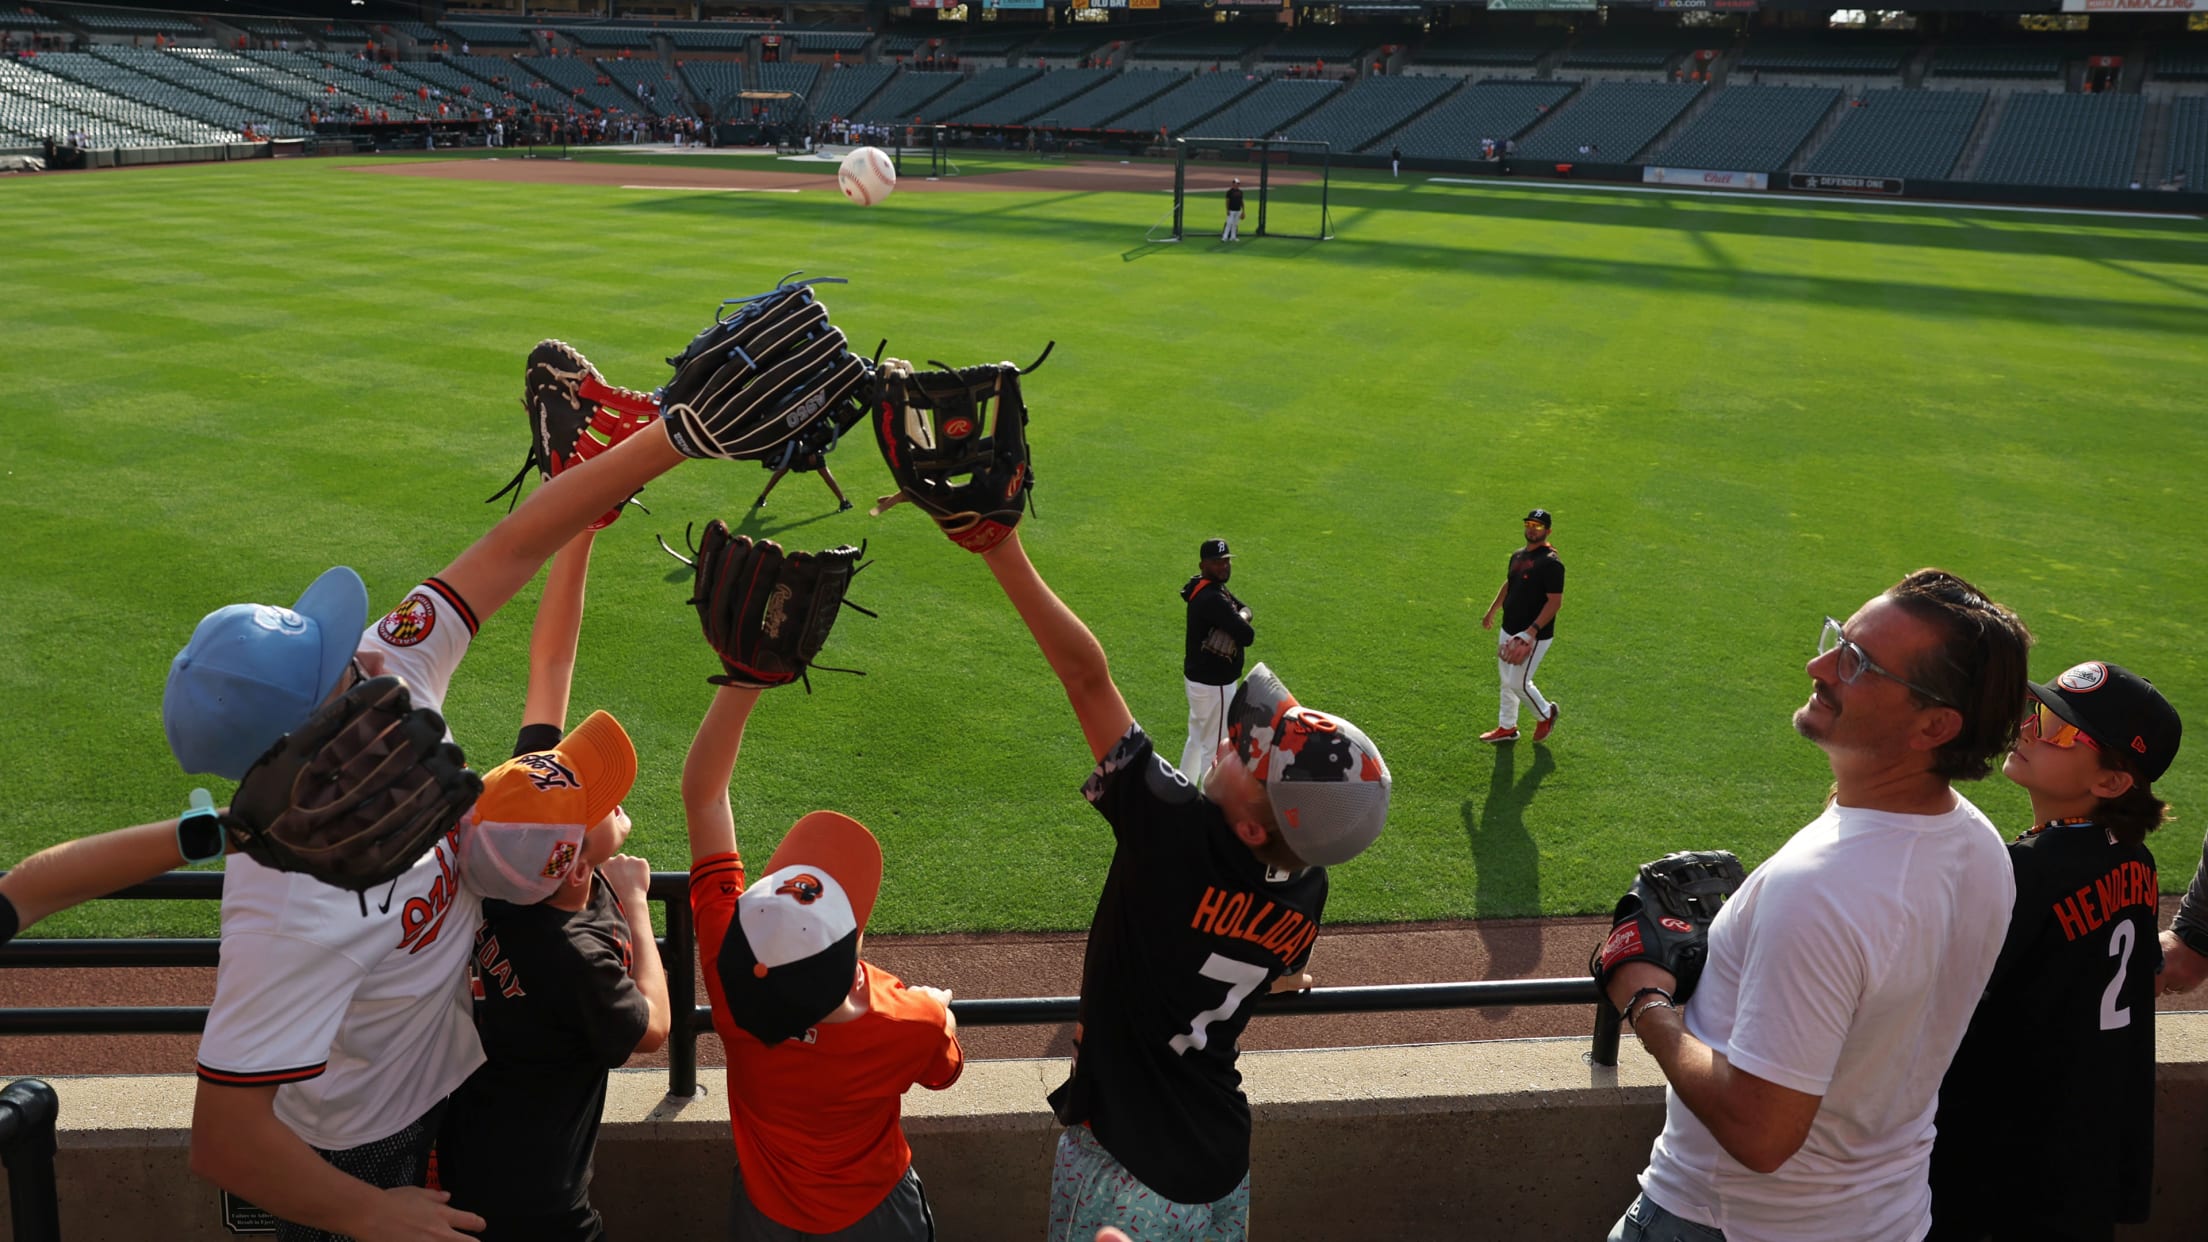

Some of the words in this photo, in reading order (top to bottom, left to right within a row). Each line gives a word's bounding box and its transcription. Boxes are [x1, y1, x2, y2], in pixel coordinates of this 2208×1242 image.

[1820, 177, 1864, 187] DEFENDER
[1866, 180, 1884, 189] ONE
[1191, 886, 1318, 966] HOLLIDAY
[1168, 952, 1269, 1057] 7
[2100, 918, 2136, 1031] 2
